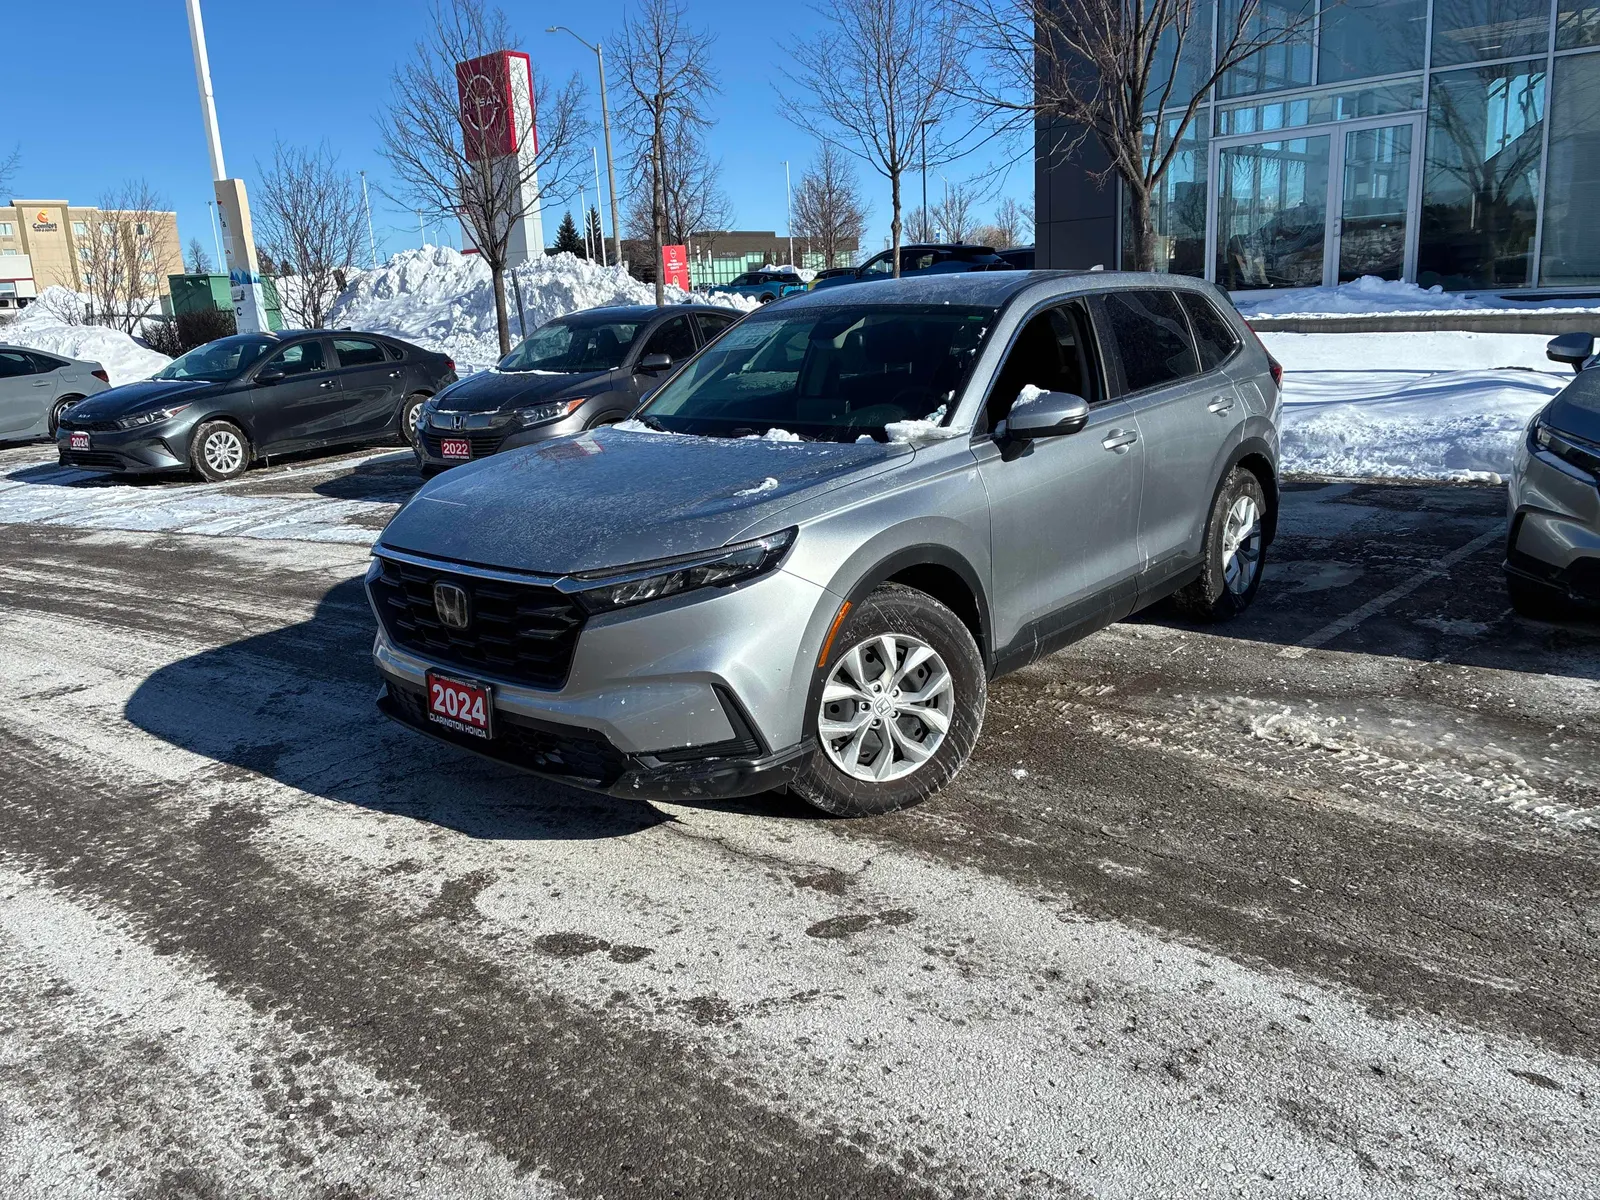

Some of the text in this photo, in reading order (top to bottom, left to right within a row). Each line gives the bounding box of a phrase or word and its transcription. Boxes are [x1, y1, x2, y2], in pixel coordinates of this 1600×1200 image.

[463, 95, 501, 110] NISAN
[71, 437, 89, 447] 2024
[443, 442, 469, 455] 2022
[432, 683, 486, 726] 2024
[429, 712, 487, 739] CLARINGTON HONDA
